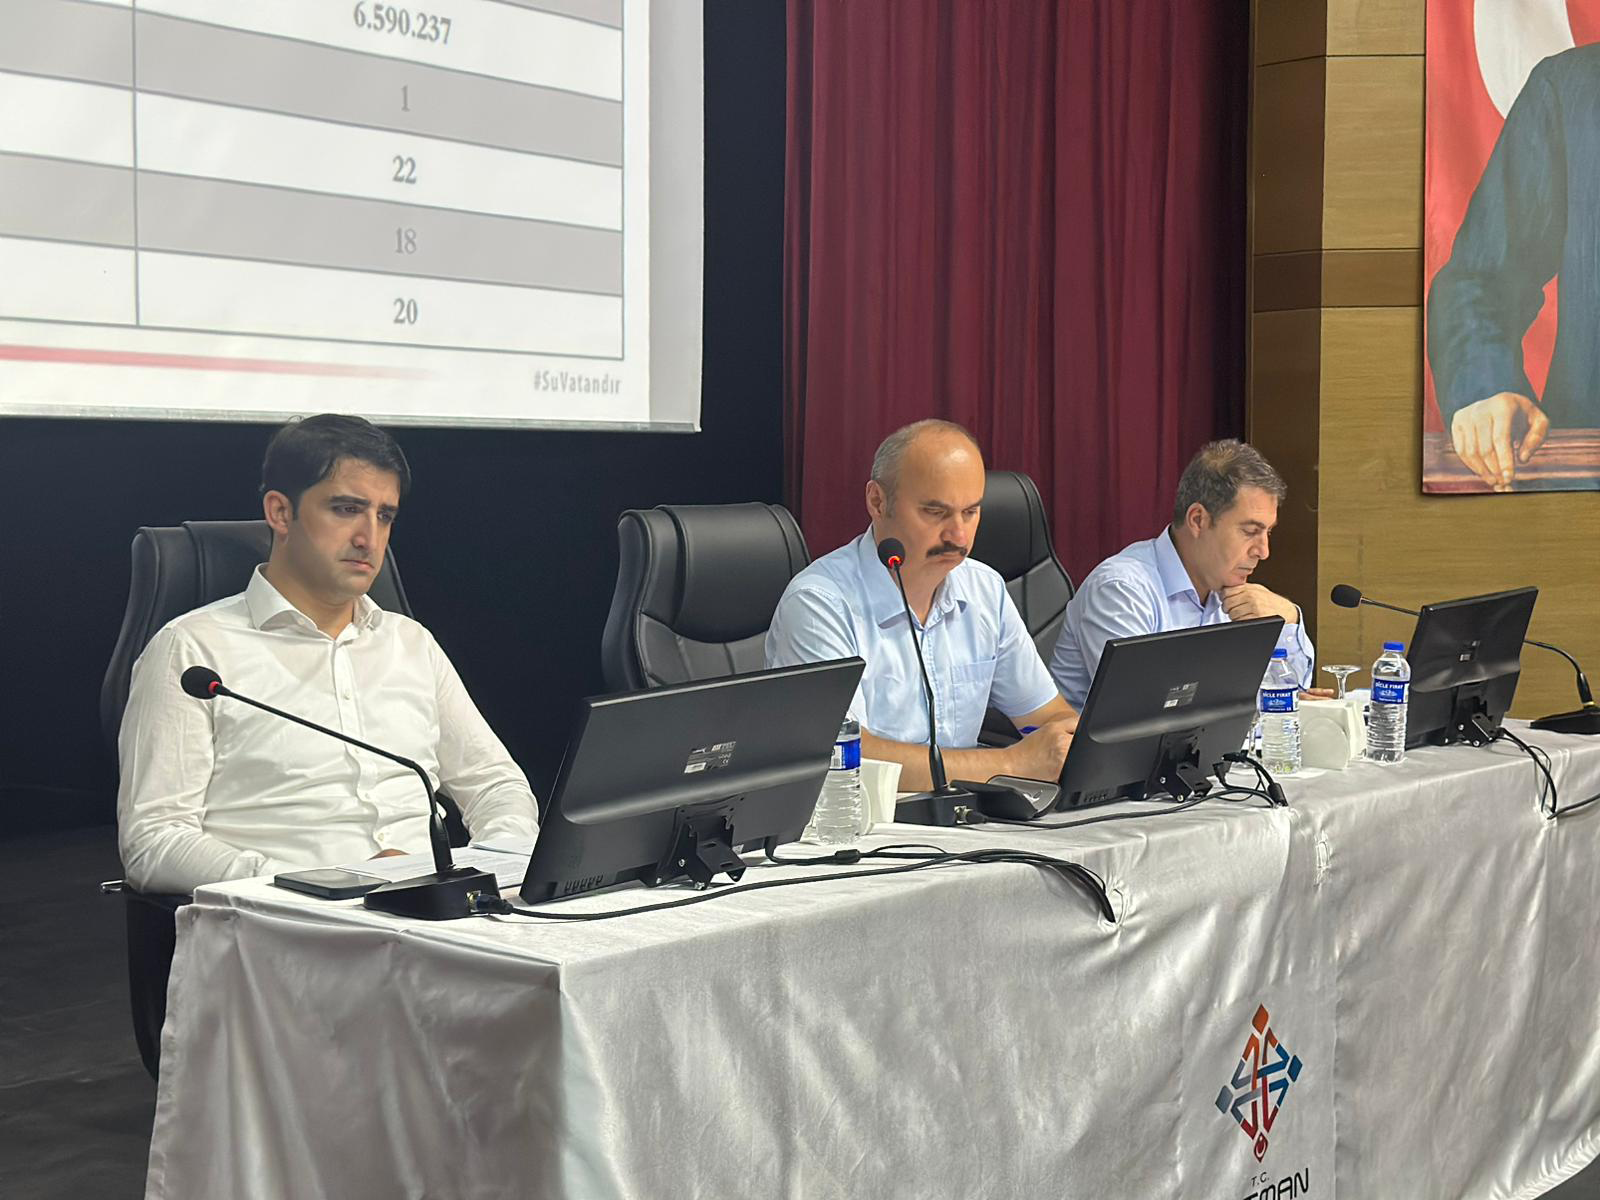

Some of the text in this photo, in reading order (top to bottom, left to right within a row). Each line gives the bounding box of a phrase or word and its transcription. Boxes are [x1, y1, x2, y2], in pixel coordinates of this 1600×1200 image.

[353, 0, 451, 45] 6.590.237
[401, 84, 411, 112] 1
[392, 155, 417, 184] 22
[394, 226, 417, 254] 18
[393, 297, 418, 325] 20
[1251, 1171, 1270, 1187] T.C.
